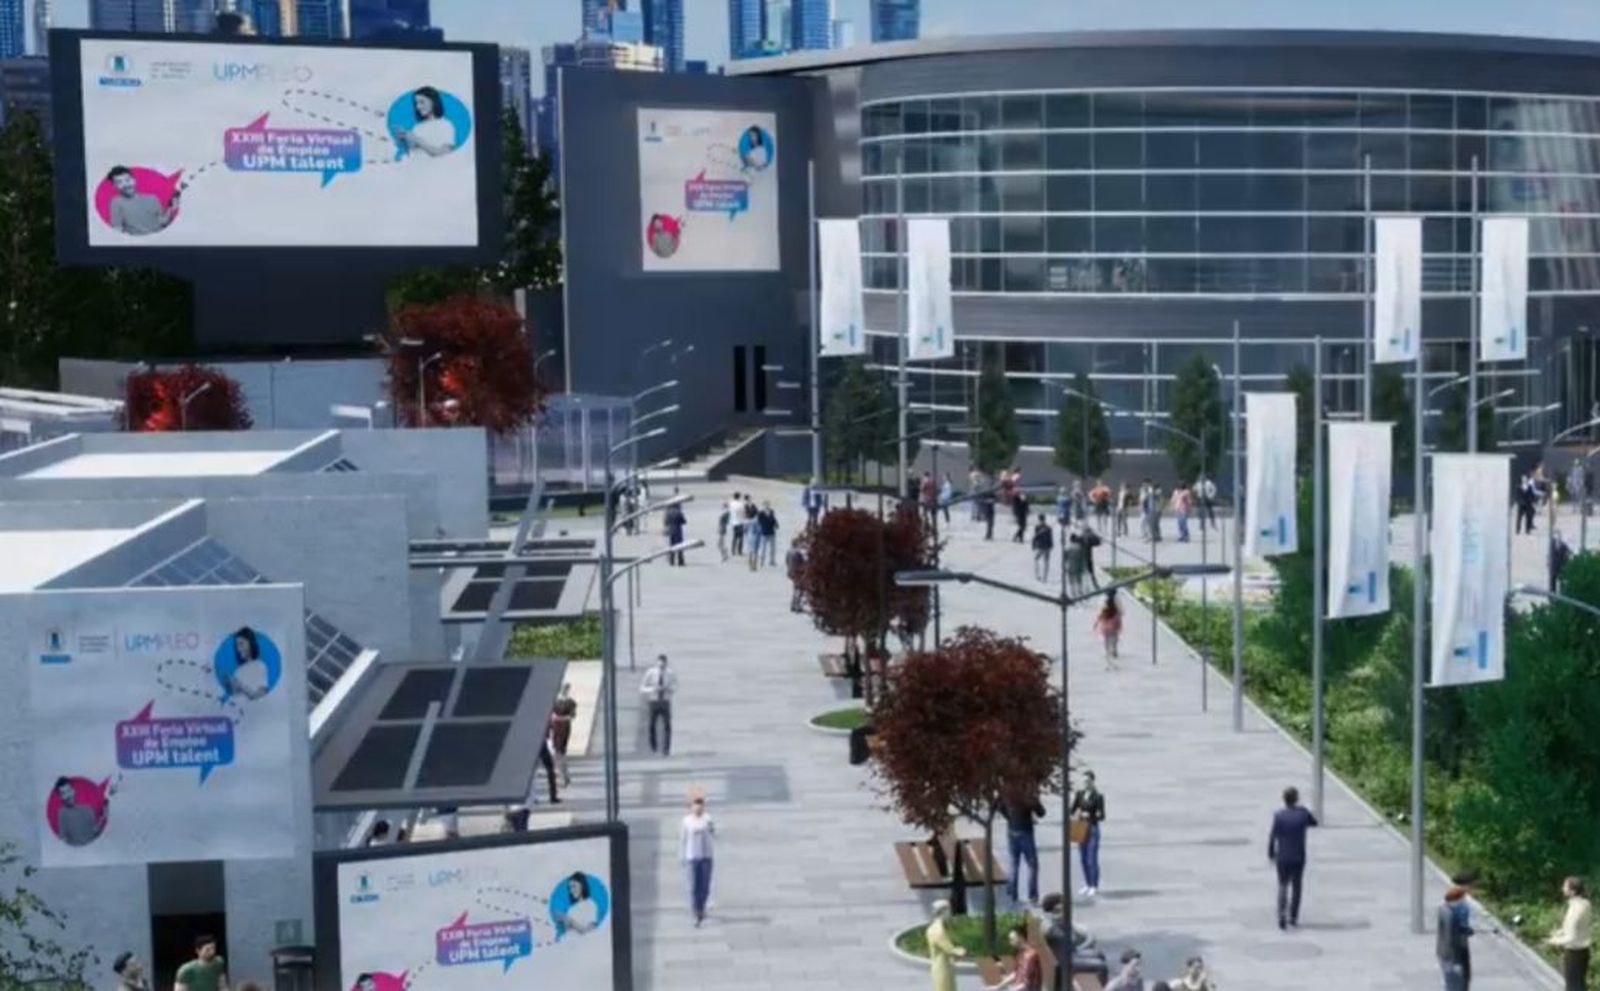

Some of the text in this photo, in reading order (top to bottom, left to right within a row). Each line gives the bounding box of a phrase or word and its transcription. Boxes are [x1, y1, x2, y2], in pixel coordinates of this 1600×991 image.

[267, 133, 304, 144] Feria
[306, 133, 355, 145] Virtual
[277, 145, 330, 156] Empleo
[242, 155, 345, 169] UPM talent
[152, 723, 184, 736] Feria
[185, 721, 228, 735] Virtual
[161, 735, 208, 749] Empleo
[131, 746, 220, 765] UPM talent
[448, 943, 521, 963] UPM talent
